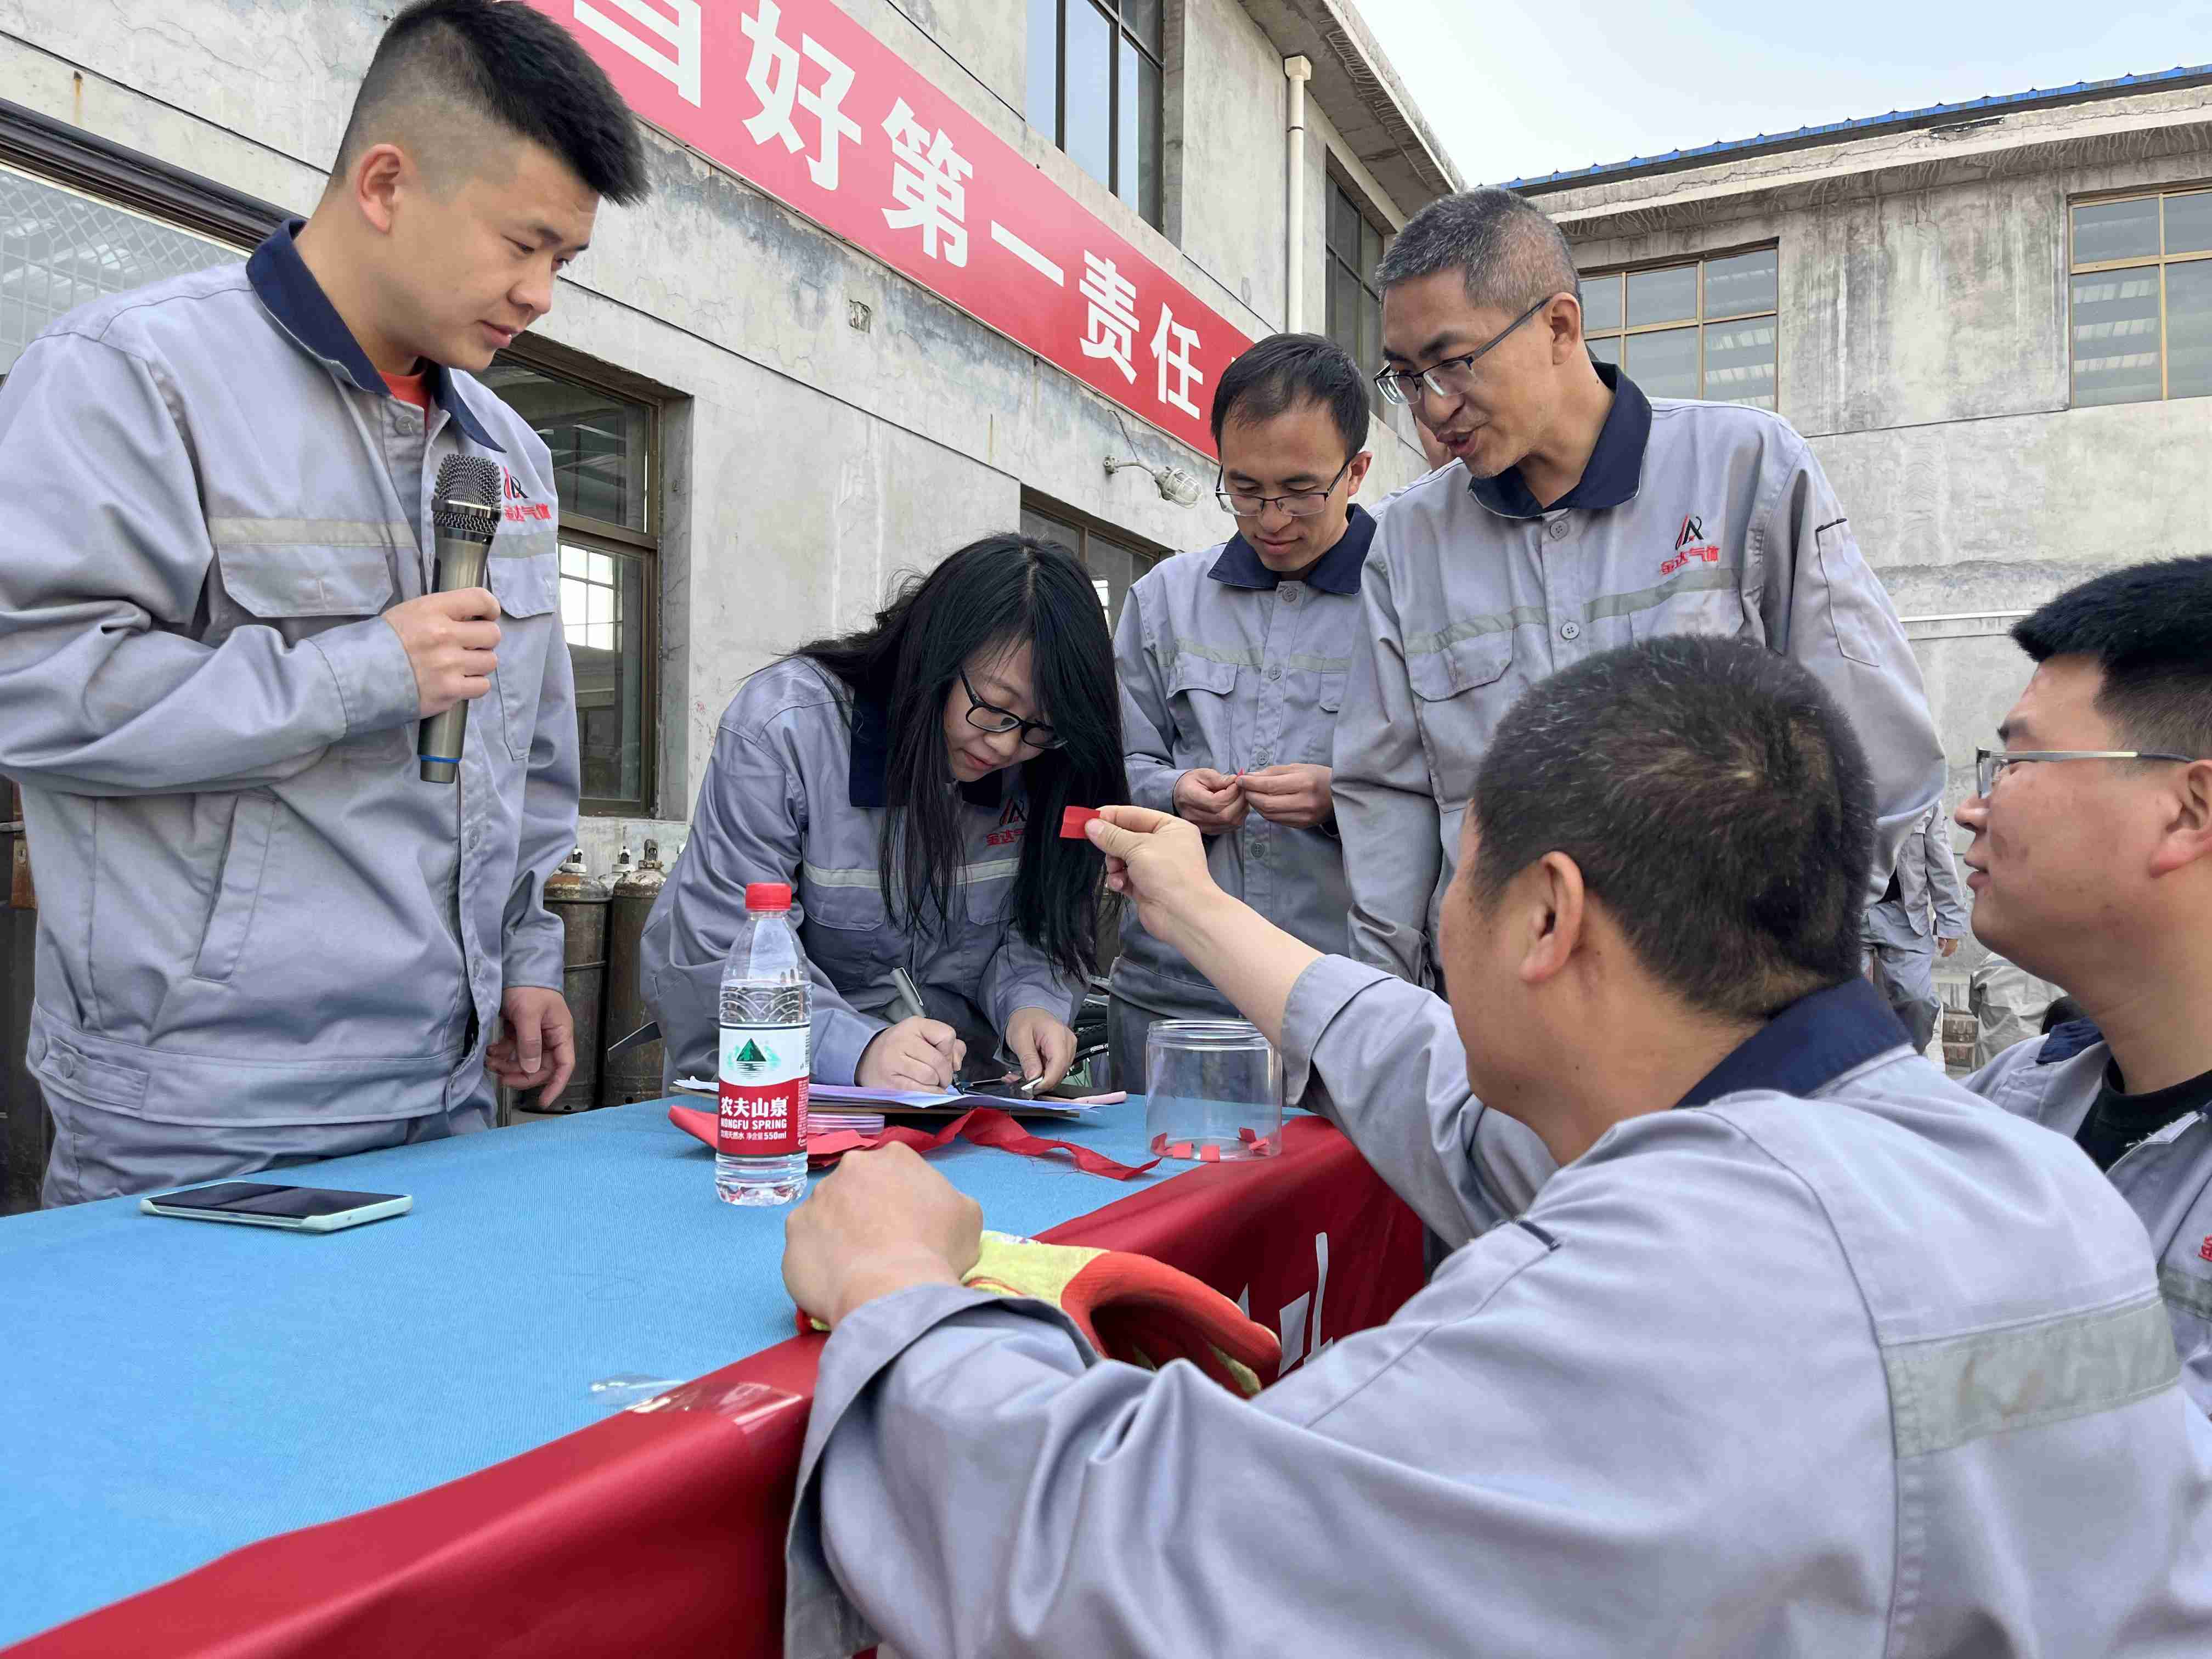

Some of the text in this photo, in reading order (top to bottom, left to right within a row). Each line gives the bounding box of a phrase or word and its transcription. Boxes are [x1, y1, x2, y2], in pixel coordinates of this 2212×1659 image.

[720, 1096, 788, 1118] 农夫山泉
[720, 1118, 787, 1130] NONGFU SPRING
